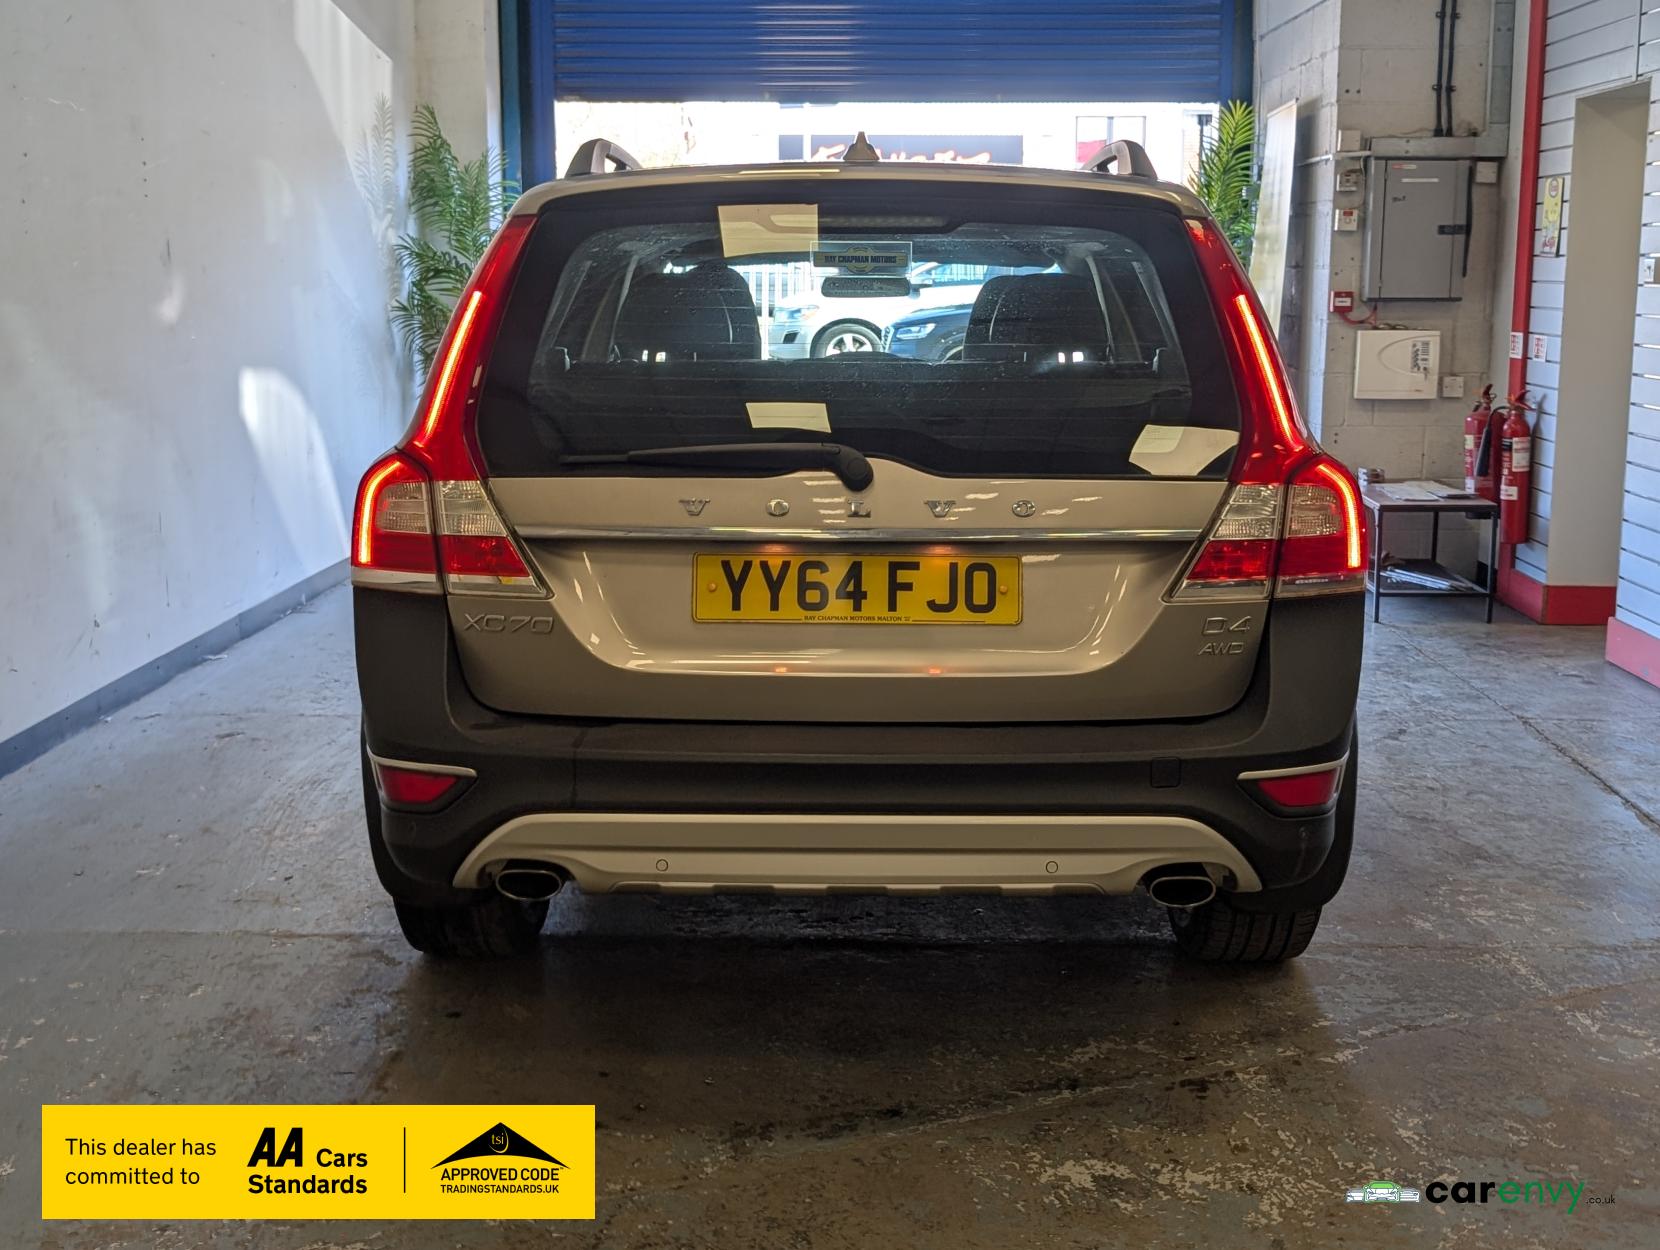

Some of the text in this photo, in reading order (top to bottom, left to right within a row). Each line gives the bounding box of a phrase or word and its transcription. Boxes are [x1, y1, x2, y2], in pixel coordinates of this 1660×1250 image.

[838, 255, 869, 264] CHAPMAN
[870, 255, 897, 264] MOTORS
[679, 499, 1036, 518] VOLVO
[720, 559, 998, 614] YY64 FJO
[464, 613, 554, 634] XC70
[1202, 615, 1252, 635] D4
[1198, 641, 1245, 655] AWD
